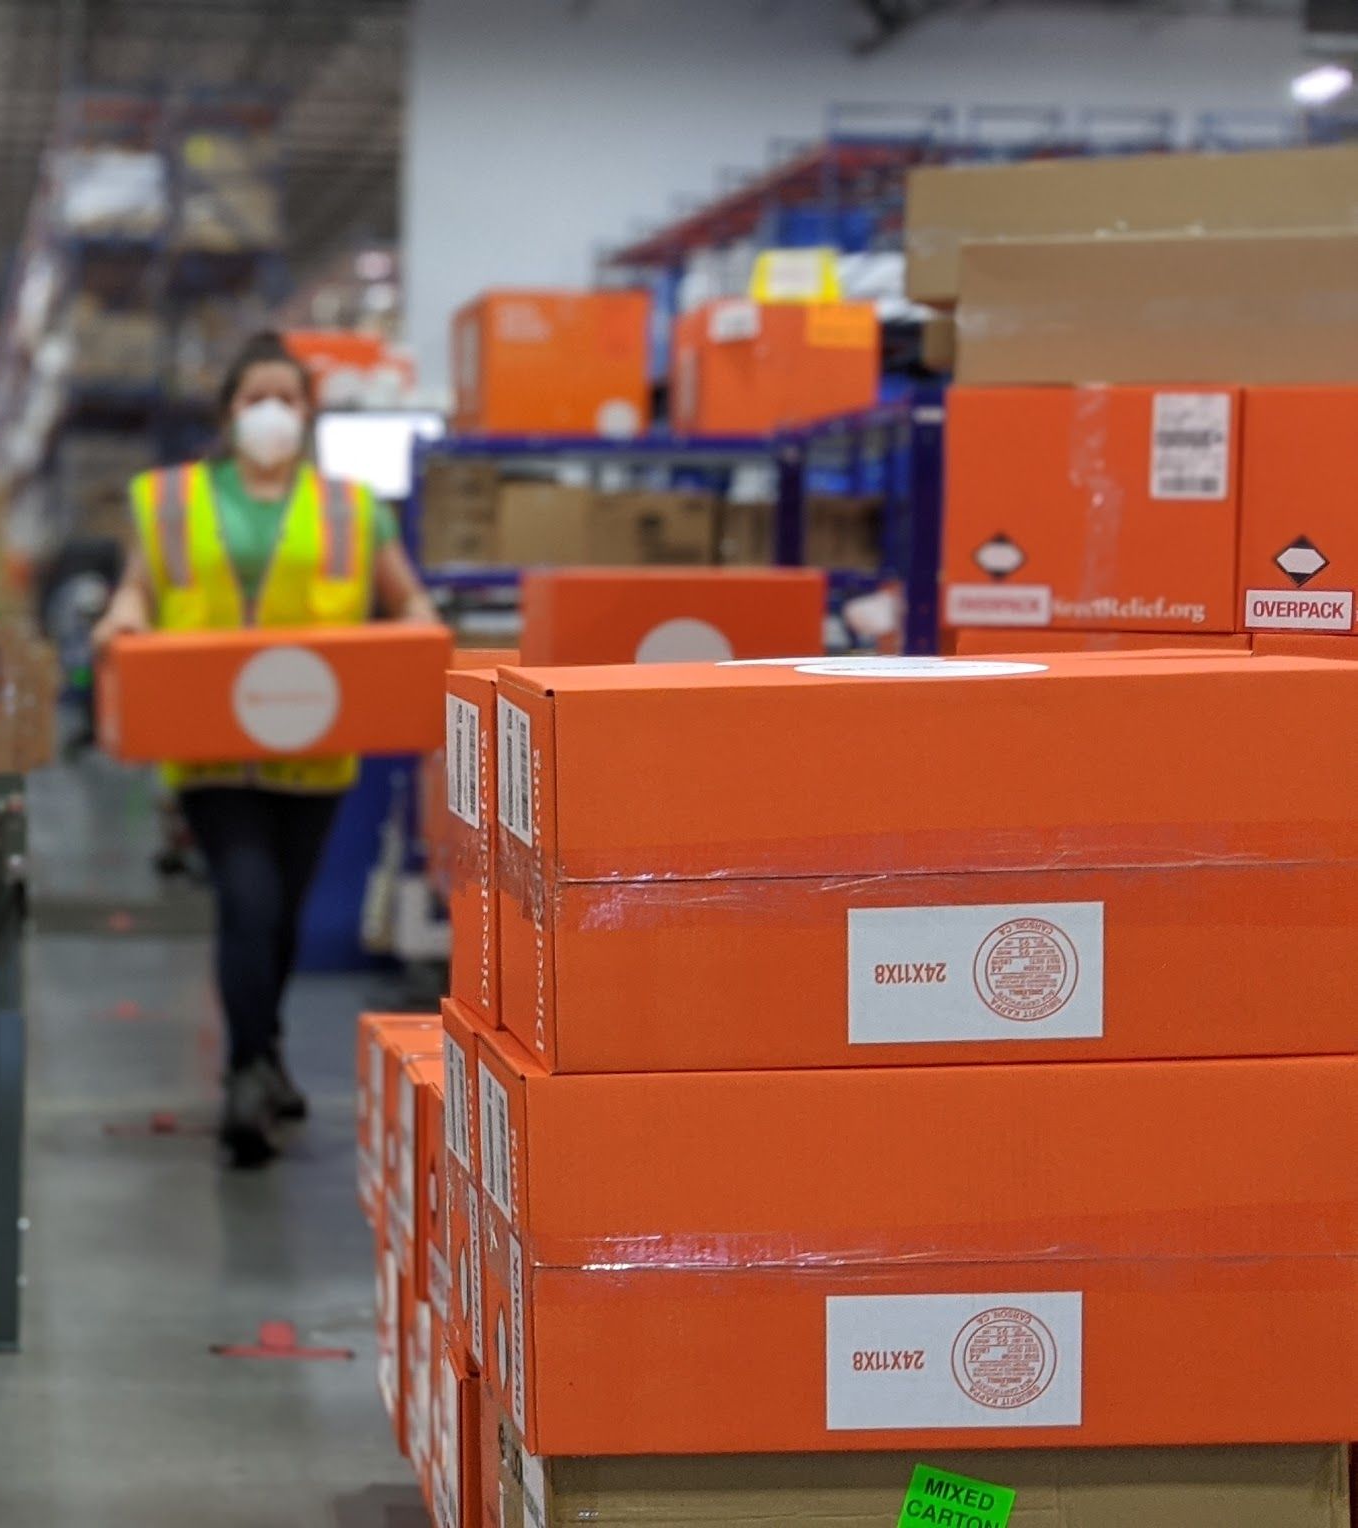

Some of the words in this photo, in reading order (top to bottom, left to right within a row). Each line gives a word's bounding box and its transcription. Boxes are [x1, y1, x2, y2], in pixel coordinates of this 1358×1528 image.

[1054, 596, 1206, 623] irectRelief.org
[1253, 600, 1344, 619] OVERPACK
[875, 962, 946, 984] 24X11X8
[512, 1256, 521, 1416] OVERPACK
[853, 1350, 924, 1372] 24X11X8
[924, 1477, 995, 1512] MIXED
